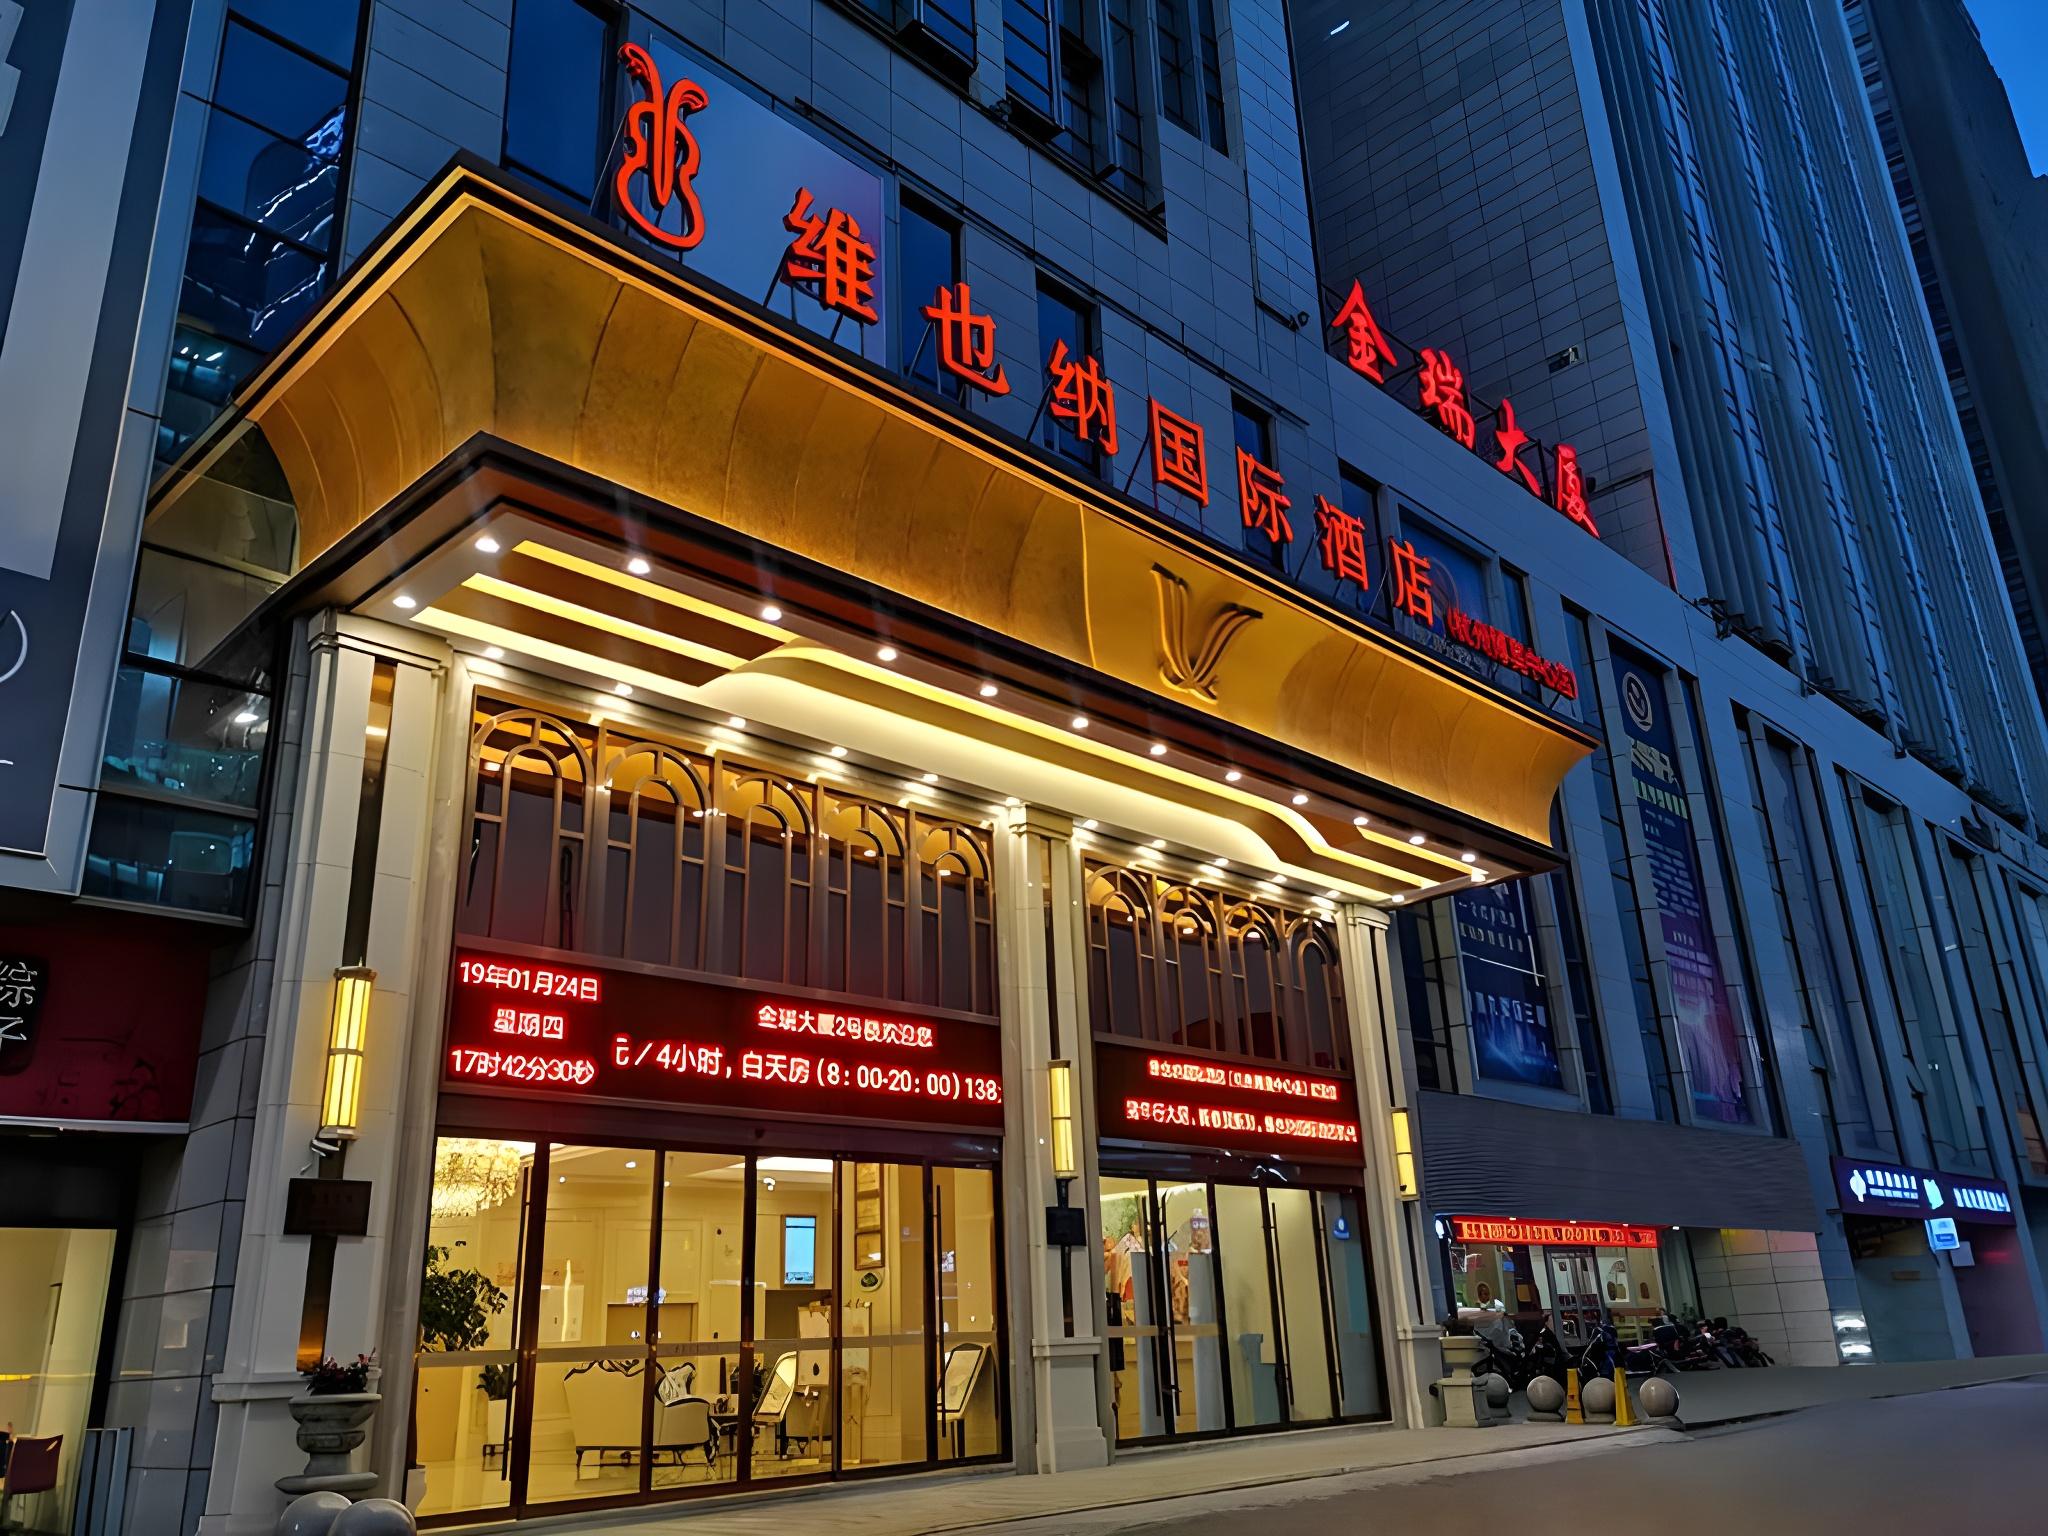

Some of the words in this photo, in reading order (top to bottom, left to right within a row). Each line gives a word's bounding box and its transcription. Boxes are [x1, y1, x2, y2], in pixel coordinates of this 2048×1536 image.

[783, 187, 1434, 628] 维也纳国际酒店
[1332, 278, 1600, 538] 金瑞大厦
[460, 961, 598, 1001] 19年01月24日
[451, 1049, 595, 1085] 17时42分30秒
